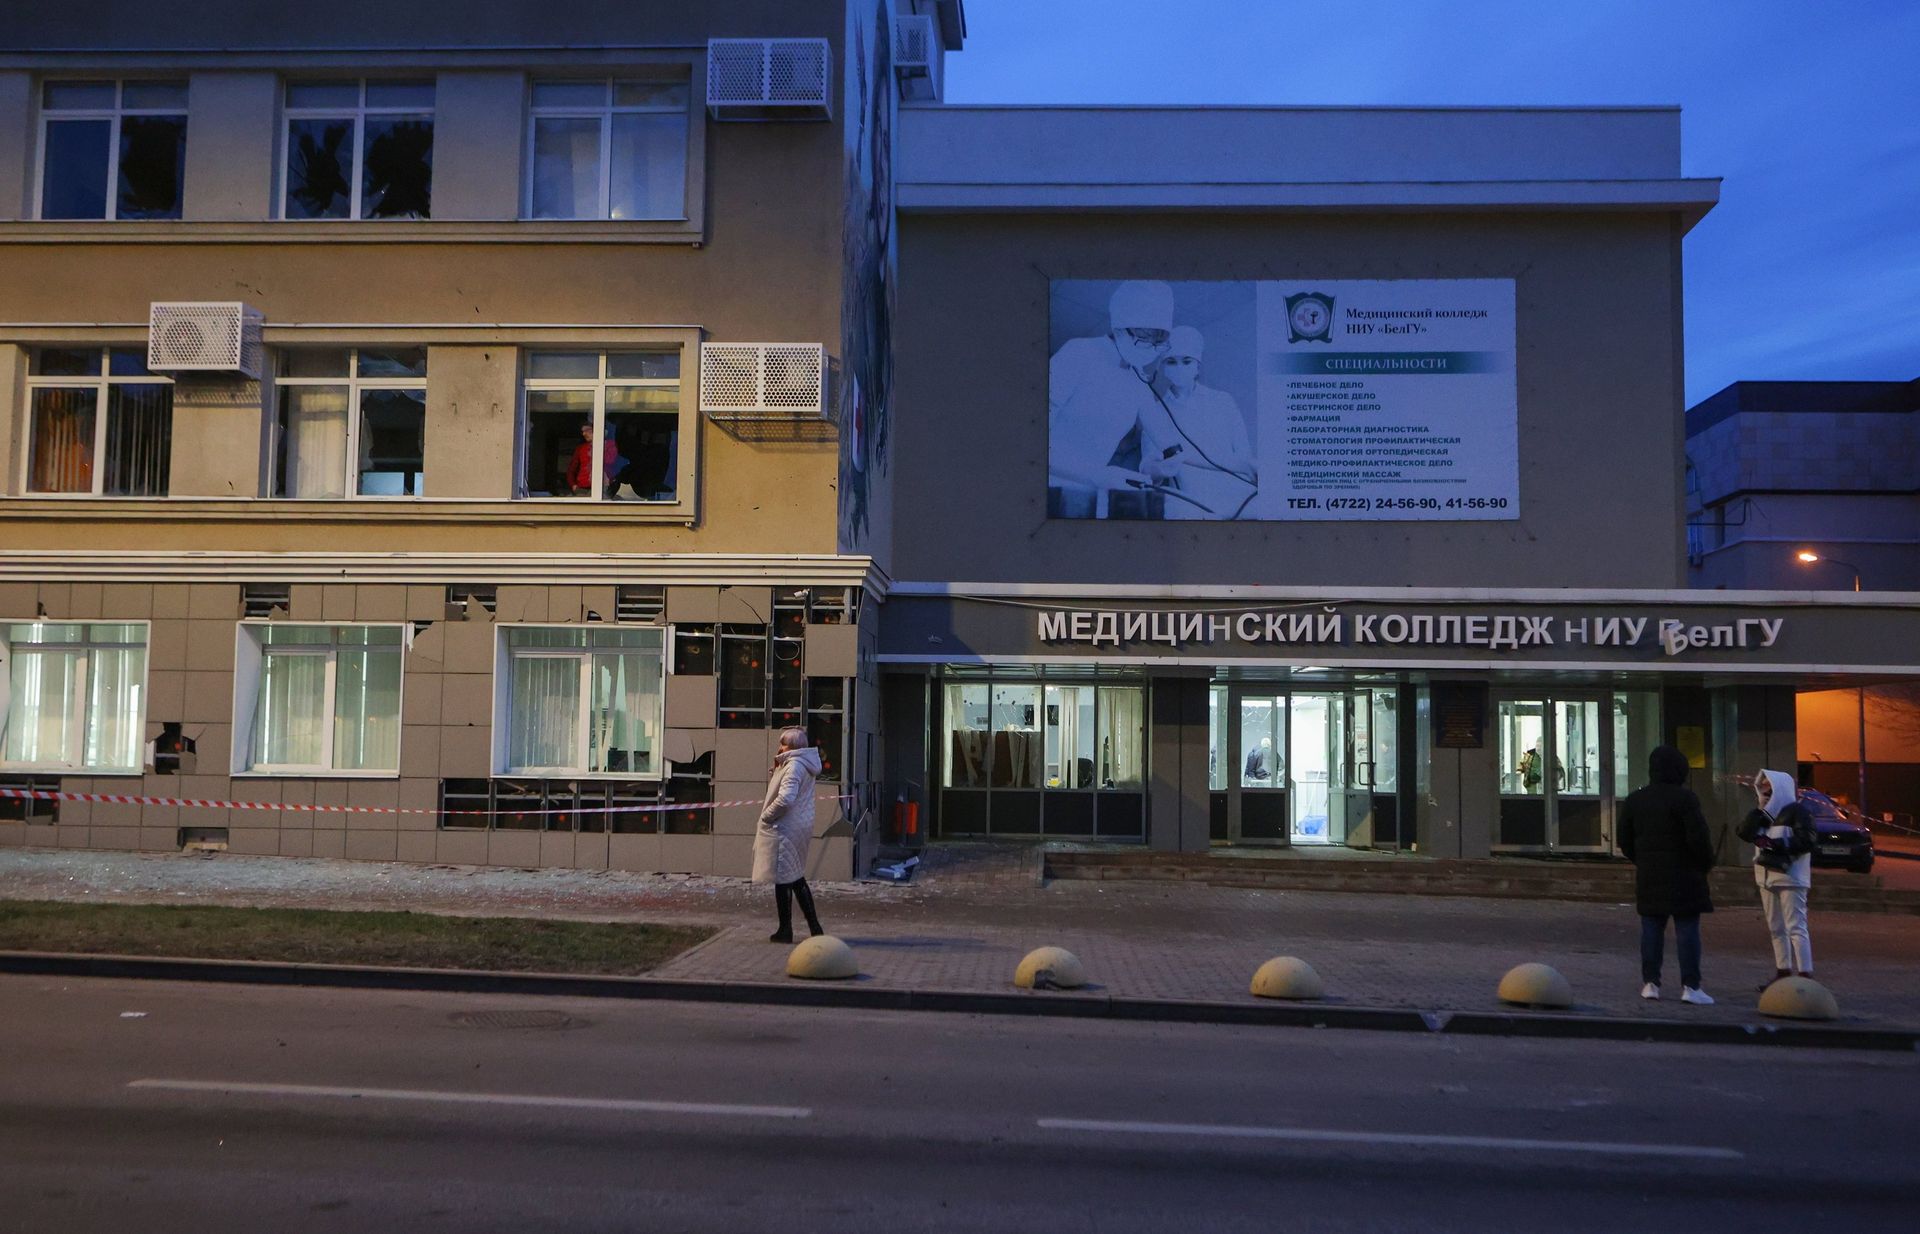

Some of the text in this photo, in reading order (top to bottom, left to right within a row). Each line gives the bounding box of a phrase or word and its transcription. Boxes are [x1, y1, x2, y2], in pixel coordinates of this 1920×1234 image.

[1346, 308, 1488, 320] Медицинский колледж
[1346, 323, 1427, 334] НИУ «БелГУ»
[1325, 358, 1447, 370] СПЕЦИАЛЬНОСТИ
[1339, 382, 1364, 390] ДЕЛО
[1351, 393, 1376, 401] ДЕЛО
[1356, 404, 1381, 412] ДЕЛО
[1290, 415, 1341, 423] ФАРМАЦИЯ
[1363, 426, 1429, 434] ДИАГНОСТИКА
[1290, 448, 1448, 456] СТОМАТОЛОГИЯ ОРТОПЕДИЧЕСКАЯ
[1291, 470, 1360, 479] МЕДИЦИНСКИЙ
[1287, 497, 1508, 511] ТЕЛ. (4722) 24-56-90, 41-56-90
[1038, 606, 1342, 646] МЕДИЦИНСКИЙ
[1355, 614, 1554, 649] КОЛЛЕДЖ
